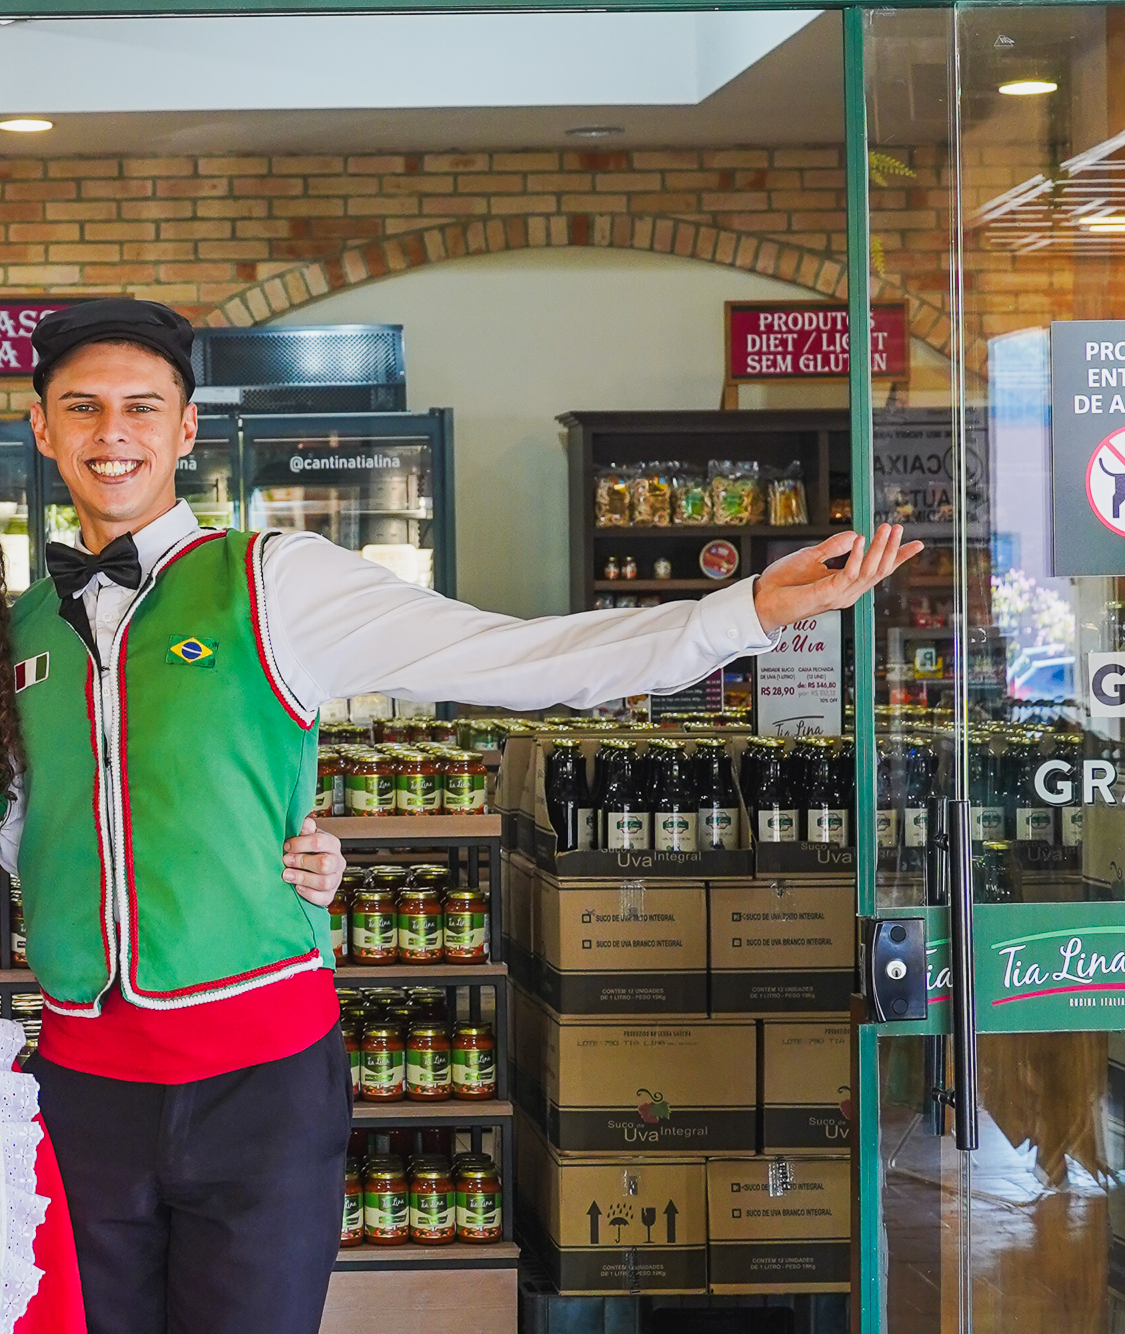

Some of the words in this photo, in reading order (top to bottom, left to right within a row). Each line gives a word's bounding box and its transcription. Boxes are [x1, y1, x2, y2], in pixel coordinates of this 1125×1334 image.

[759, 312, 876, 331] PRODUTS
[747, 334, 798, 353] DIET
[822, 332, 888, 353] LIGT
[746, 354, 794, 373] SEM
[1074, 395, 1103, 414] DE
[289, 455, 401, 473] @cantinatialina
[792, 634, 826, 653] Uva
[760, 686, 771, 696] R$
[772, 686, 795, 697] 28,90
[1034, 759, 1125, 807] GR
[617, 853, 652, 867] Uva
[654, 851, 702, 863] Integral
[817, 849, 852, 863] Uva
[799, 912, 825, 920] INTEGRAL
[595, 940, 611, 948] SUCO
[612, 940, 620, 948] DE
[926, 948, 953, 991] ia
[998, 945, 1049, 988] Tia
[1052, 937, 1125, 984] Lina
[607, 1120, 634, 1129] Suco
[809, 1117, 835, 1125] Suco
[624, 1128, 659, 1142] Uva
[660, 1126, 709, 1137] Integral
[825, 1125, 850, 1138] Uv
[806, 1208, 832, 1216] INTEGRAL
